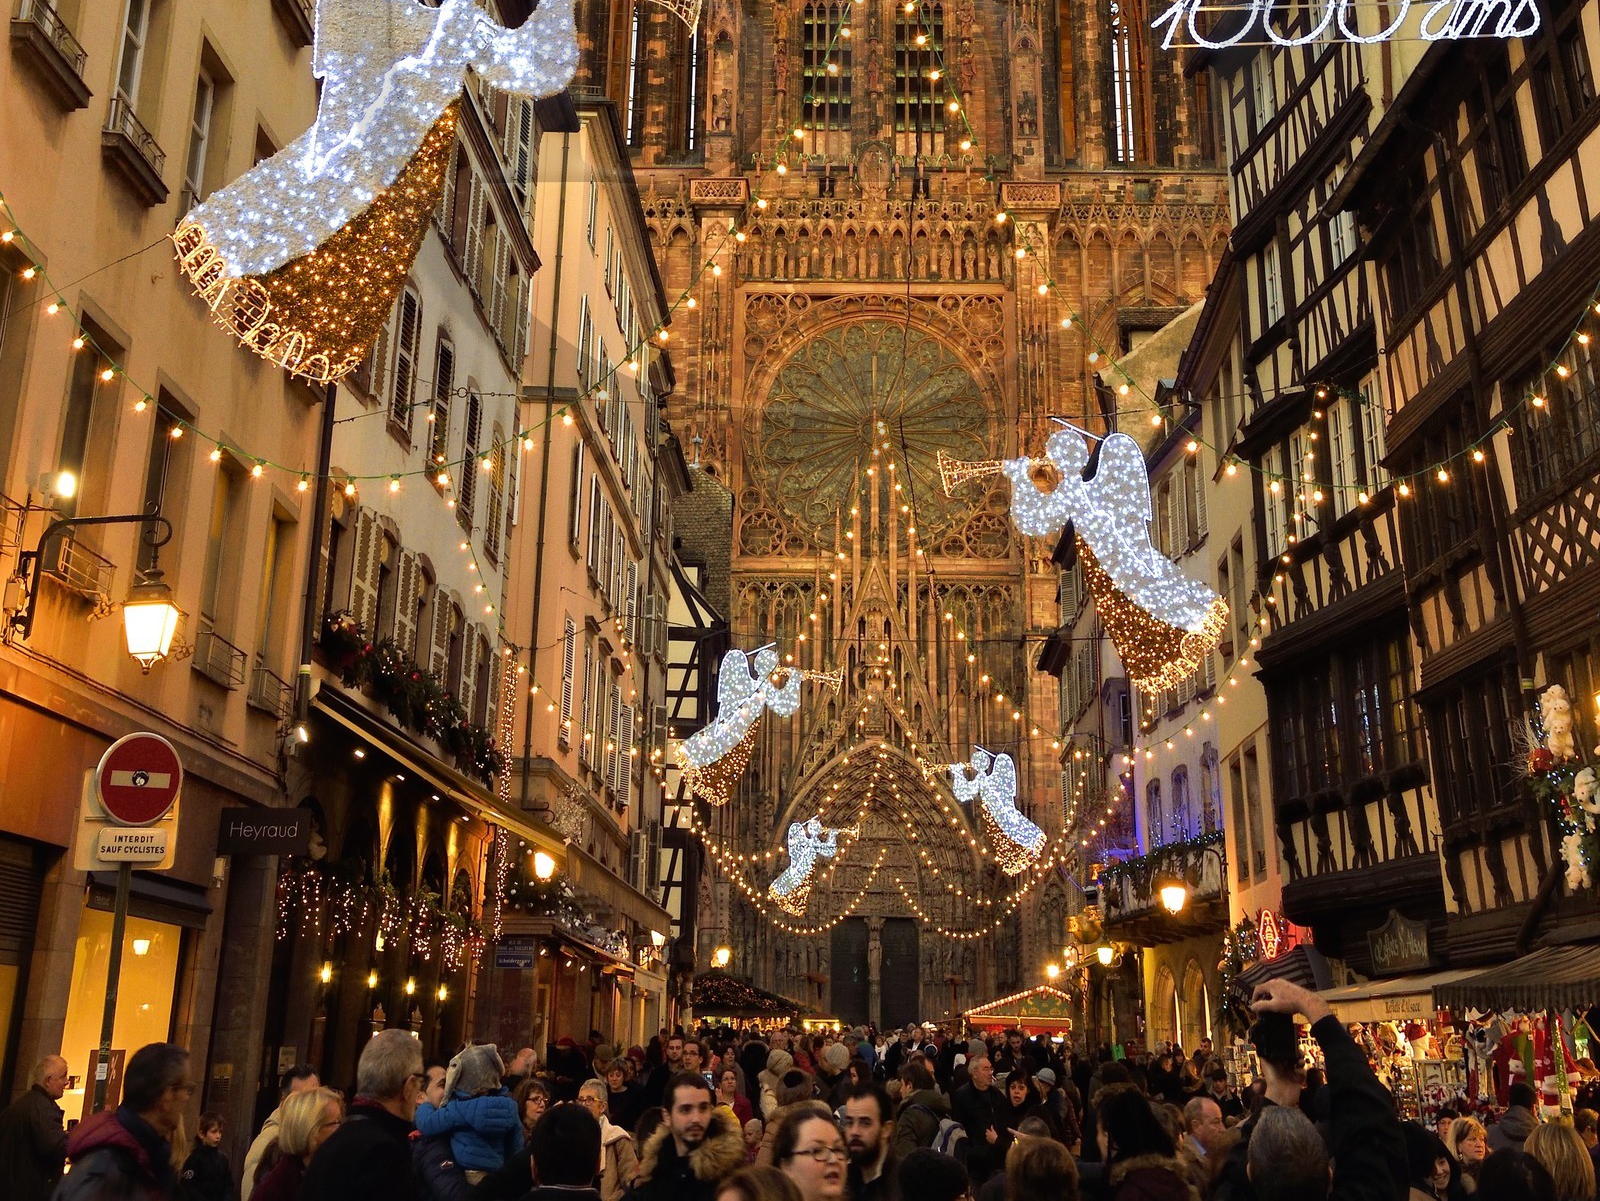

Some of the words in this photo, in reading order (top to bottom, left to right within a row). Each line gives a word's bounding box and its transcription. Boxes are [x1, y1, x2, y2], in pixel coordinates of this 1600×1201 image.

[229, 821, 299, 841] Heyraud
[114, 835, 154, 843] INTERDIT
[100, 845, 122, 854] SAUF
[124, 846, 165, 854] CYCLISTES
